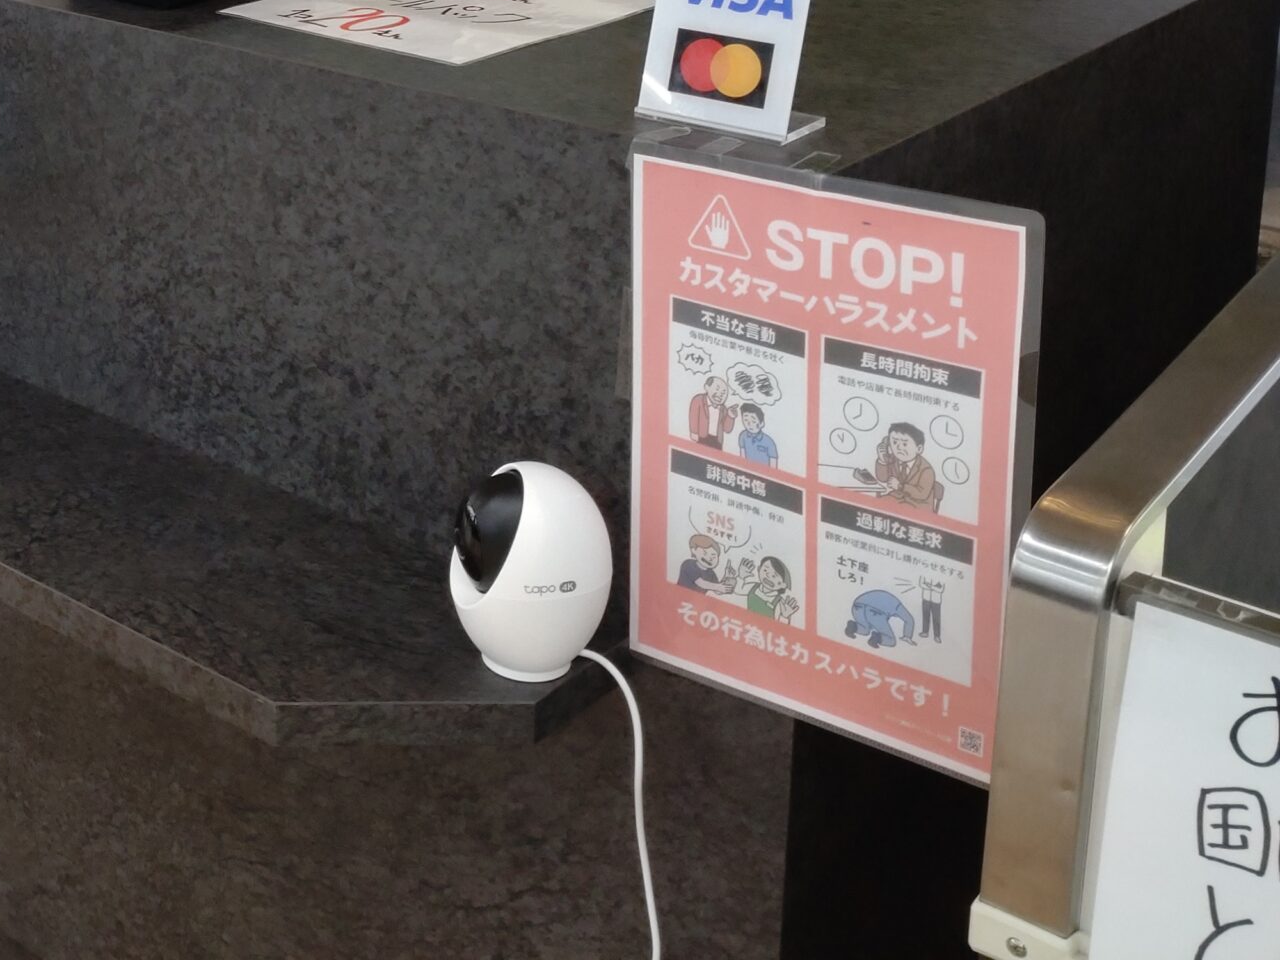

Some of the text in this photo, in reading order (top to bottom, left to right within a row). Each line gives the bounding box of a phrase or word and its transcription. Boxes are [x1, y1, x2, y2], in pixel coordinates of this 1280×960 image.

[766, 219, 965, 308] STOP!
[679, 256, 979, 349] カスタマーハラスメント
[700, 309, 777, 345] 不当な言動
[684, 352, 705, 366] バカ
[859, 351, 951, 387] 長時間拘束
[705, 463, 767, 497] 誹謗中傷
[706, 511, 735, 532] SNS
[855, 511, 944, 550] 過剰な要求
[836, 554, 870, 575] 土下座
[523, 584, 556, 596] tapo
